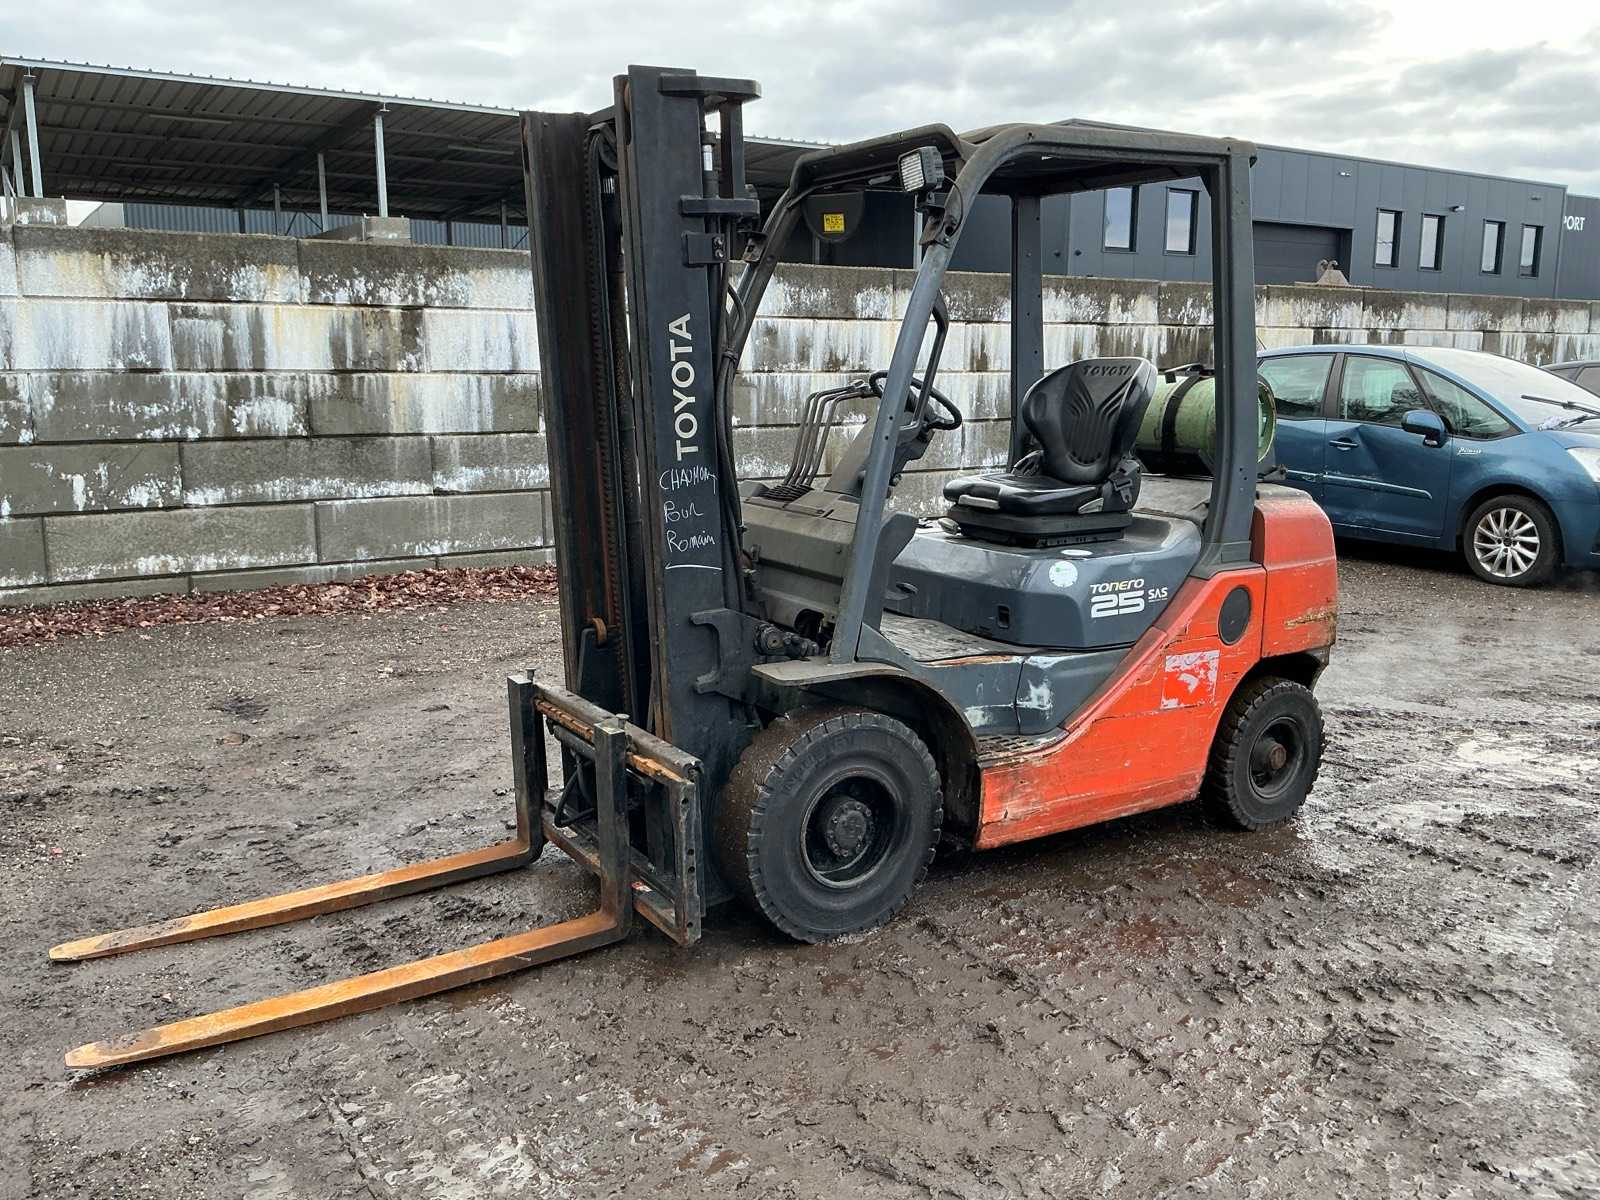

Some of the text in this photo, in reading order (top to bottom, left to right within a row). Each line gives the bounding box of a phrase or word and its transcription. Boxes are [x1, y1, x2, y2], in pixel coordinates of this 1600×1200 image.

[669, 312, 699, 462] TOYOTA
[666, 529, 716, 553] Romain
[1091, 590, 1145, 618] 25
[1148, 586, 1168, 599] SAS
